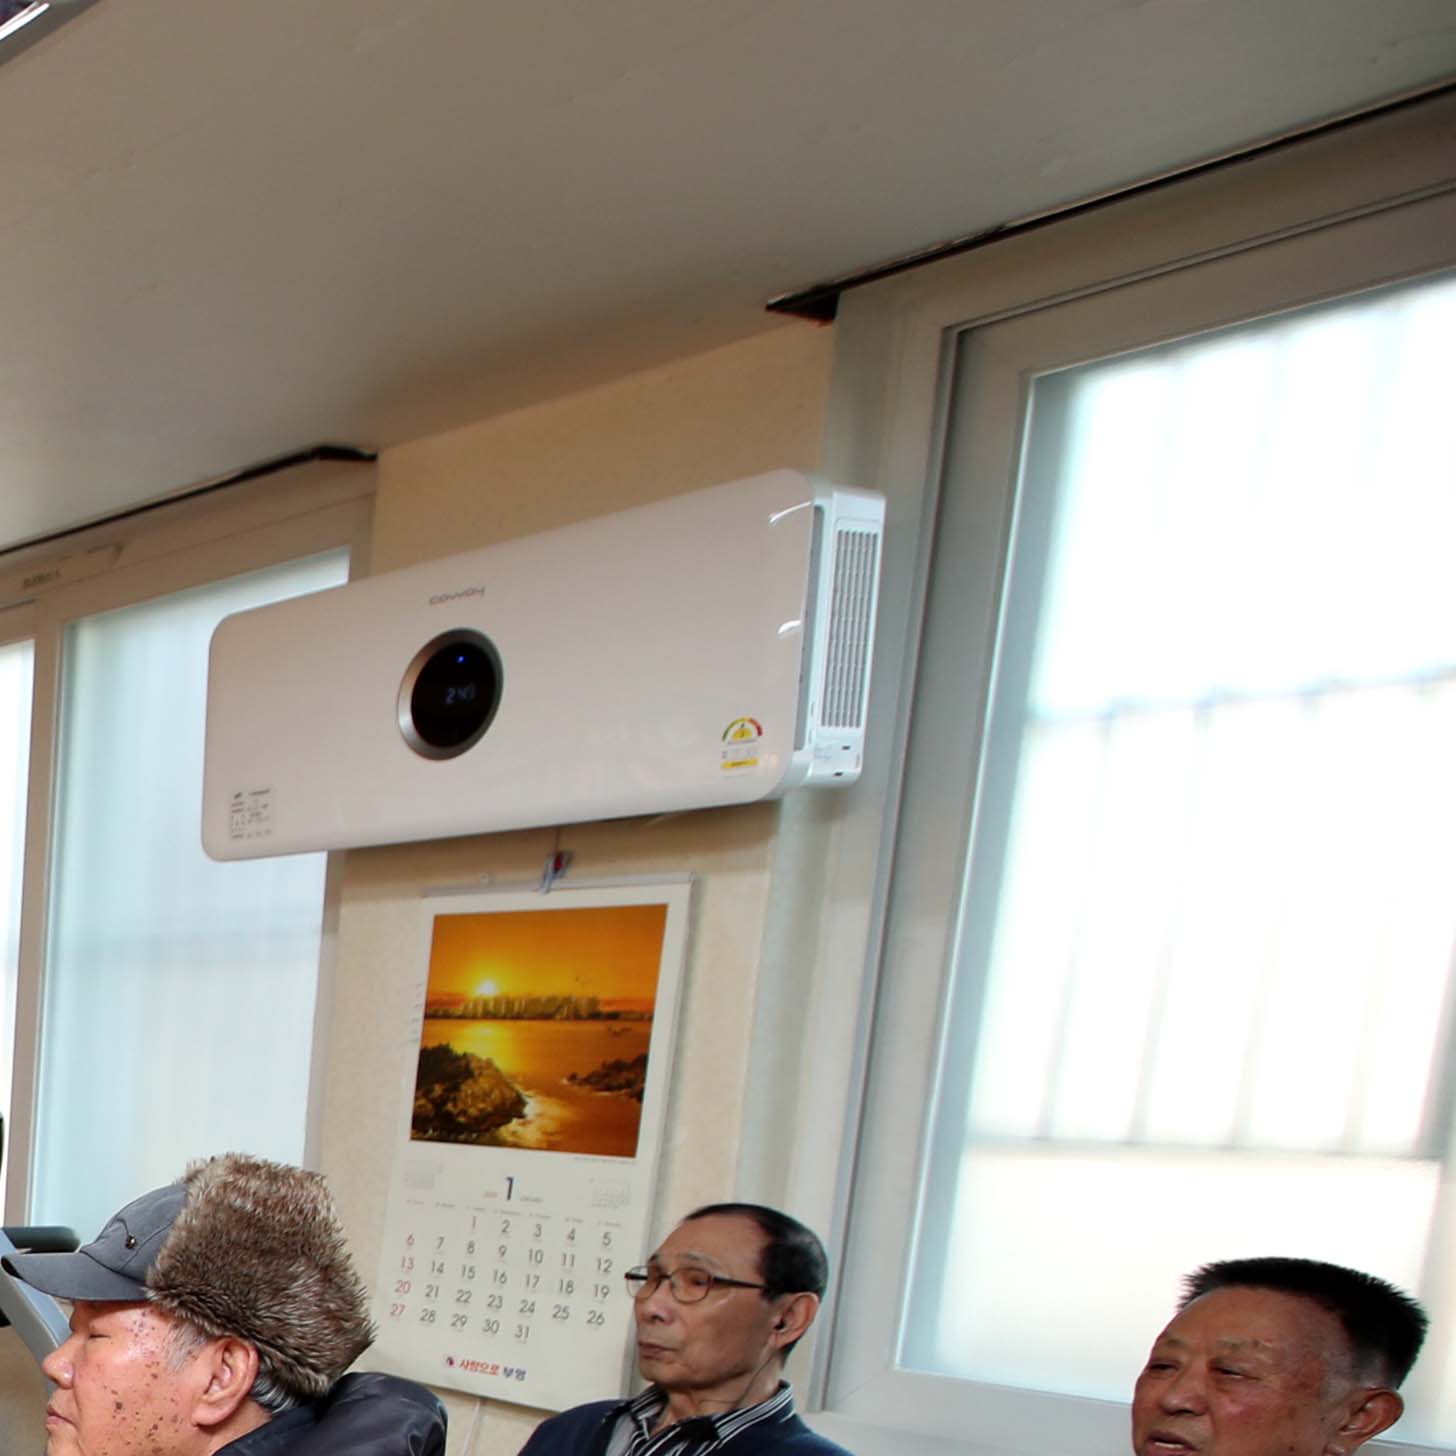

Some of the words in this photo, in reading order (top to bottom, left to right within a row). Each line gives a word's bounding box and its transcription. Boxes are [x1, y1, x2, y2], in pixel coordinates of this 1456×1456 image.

[507, 1177, 513, 1200] 1
[472, 1216, 476, 1229] 1
[502, 1220, 510, 1234] 2
[533, 1224, 542, 1237] 3
[567, 1228, 576, 1241] 4
[602, 1233, 611, 1246] 5
[406, 1234, 415, 1245] 6
[436, 1237, 444, 1249] 7
[467, 1241, 475, 1254] 8
[499, 1245, 507, 1258] 9
[529, 1250, 543, 1264] 10
[562, 1254, 575, 1268] 11
[597, 1259, 612, 1273] 12
[401, 1257, 414, 1270] 13
[432, 1261, 444, 1274] 14
[462, 1266, 475, 1279] 15
[493, 1270, 507, 1284] 16
[526, 1275, 539, 1288] 17
[560, 1280, 574, 1294] 18
[594, 1284, 609, 1298] 19
[395, 1280, 411, 1294] 20
[425, 1285, 439, 1298] 21
[456, 1291, 472, 1304] 22
[488, 1295, 503, 1309] 23
[519, 1300, 535, 1314] 24
[552, 1305, 569, 1320] 25
[587, 1311, 605, 1325] 26
[390, 1304, 406, 1317] 27
[420, 1309, 436, 1323] 28
[451, 1314, 468, 1328] 29
[482, 1319, 500, 1334] 30
[515, 1325, 529, 1339] 31
[460, 1360, 500, 1375] 사랑으로
